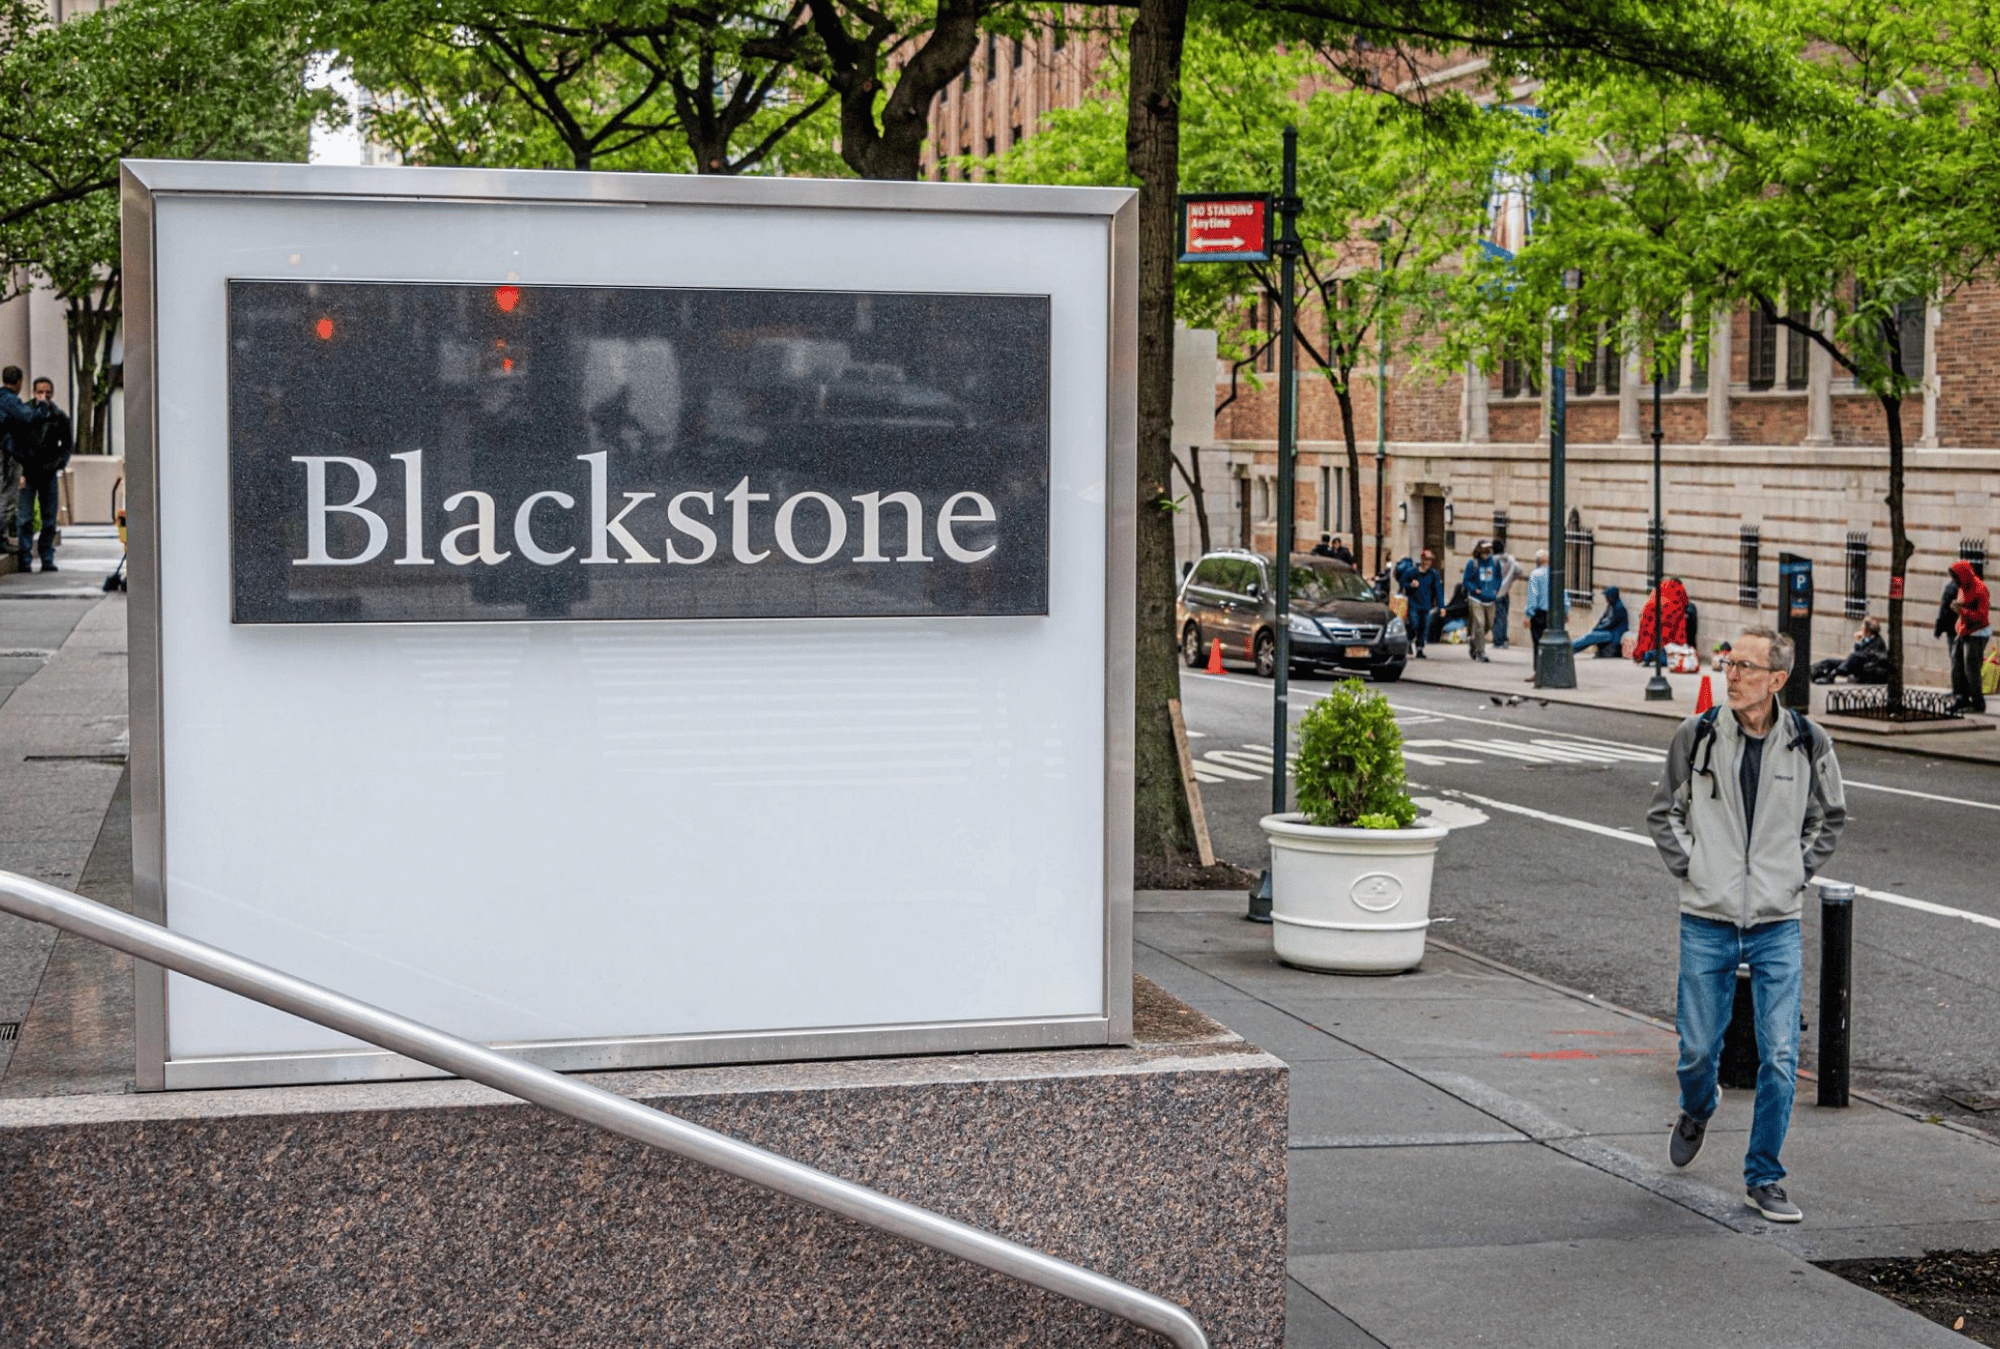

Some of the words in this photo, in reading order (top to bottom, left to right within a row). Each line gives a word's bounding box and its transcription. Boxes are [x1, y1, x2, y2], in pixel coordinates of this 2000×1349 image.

[1191, 204, 1205, 216] NO
[1206, 204, 1254, 216] STANDING
[1191, 218, 1232, 231] Anytime
[291, 449, 998, 566] Blackstone
[1796, 574, 1806, 589] P
